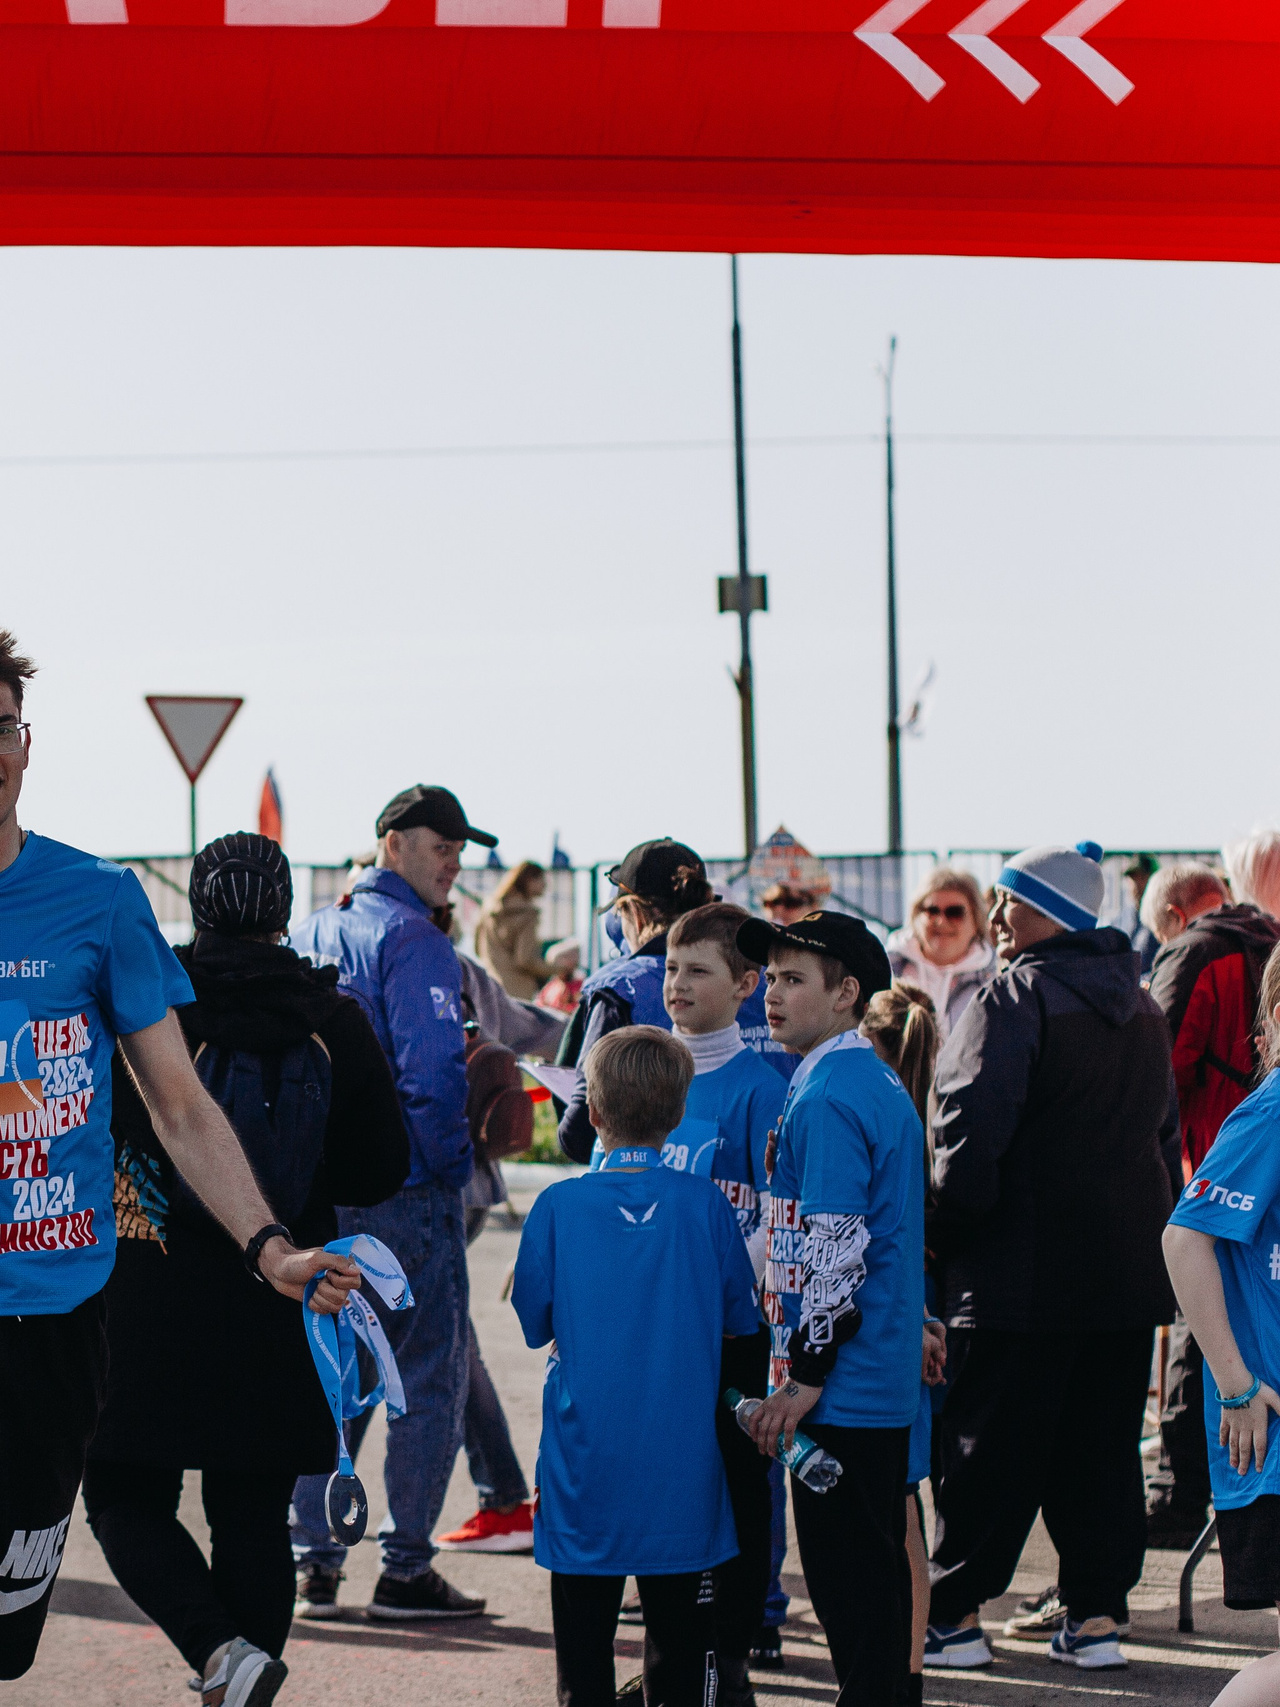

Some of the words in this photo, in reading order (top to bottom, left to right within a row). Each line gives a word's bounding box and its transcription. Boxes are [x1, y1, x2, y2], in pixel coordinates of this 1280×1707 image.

[31, 1012, 92, 1060] ЦЕЛЬ
[38, 1056, 94, 1097] 2024
[13, 1172, 75, 1221] 2024
[1209, 1187, 1256, 1212] ПСБ
